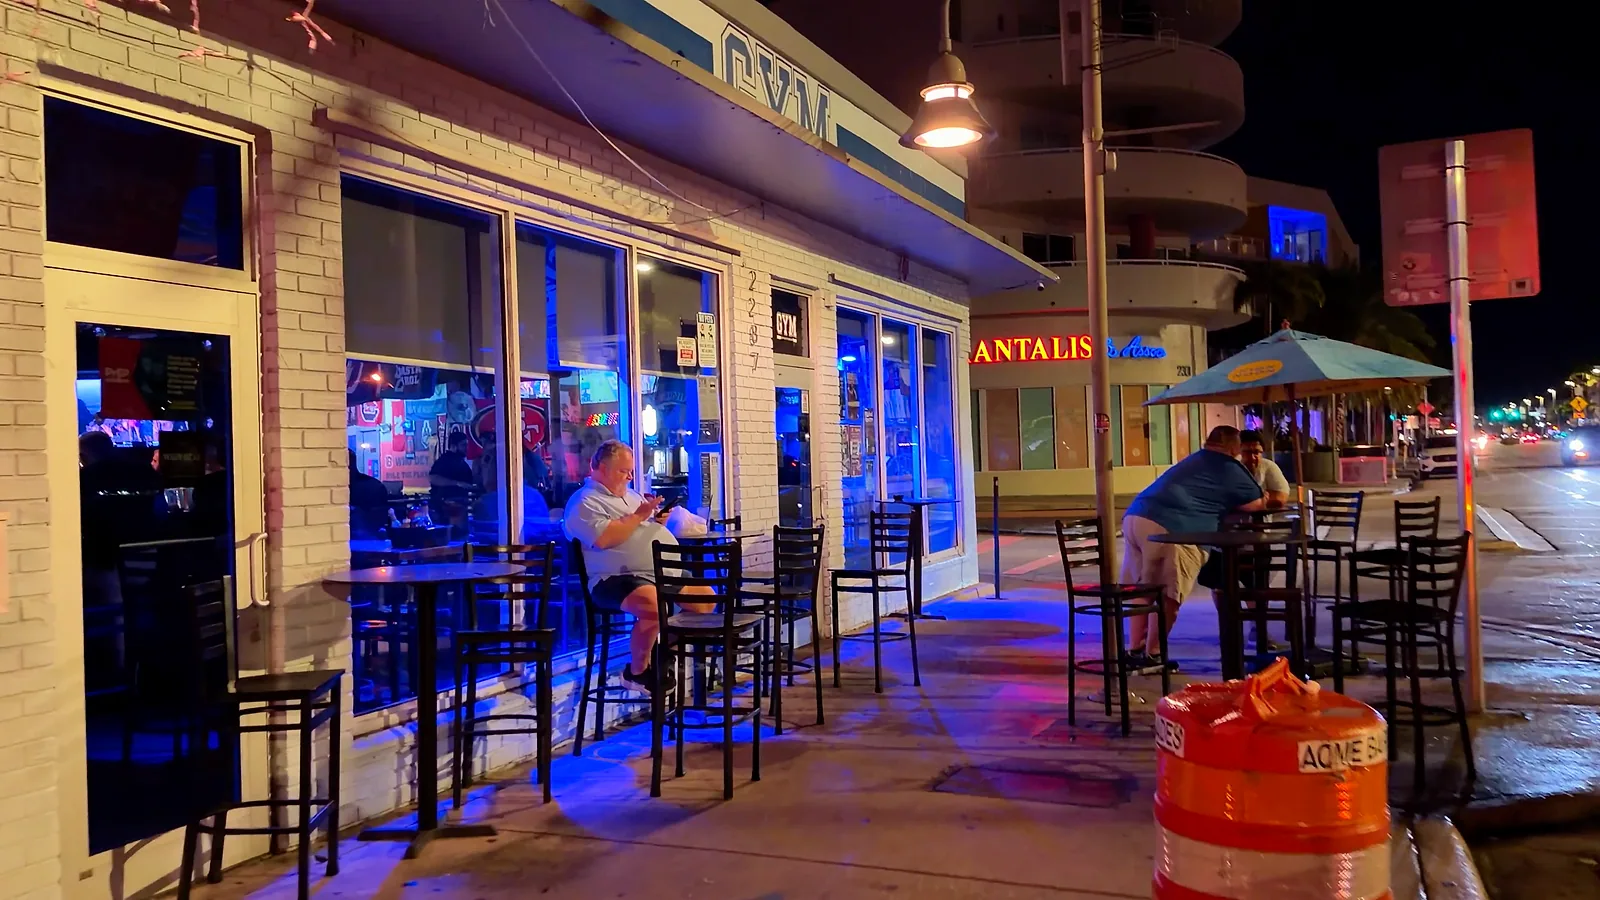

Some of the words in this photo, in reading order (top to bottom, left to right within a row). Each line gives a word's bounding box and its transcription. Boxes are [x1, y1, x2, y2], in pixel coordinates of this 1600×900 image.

[721, 22, 832, 144] GYM
[748, 270, 759, 374] 2287
[776, 311, 797, 338] GYM
[968, 334, 1092, 364] ANTALIS
